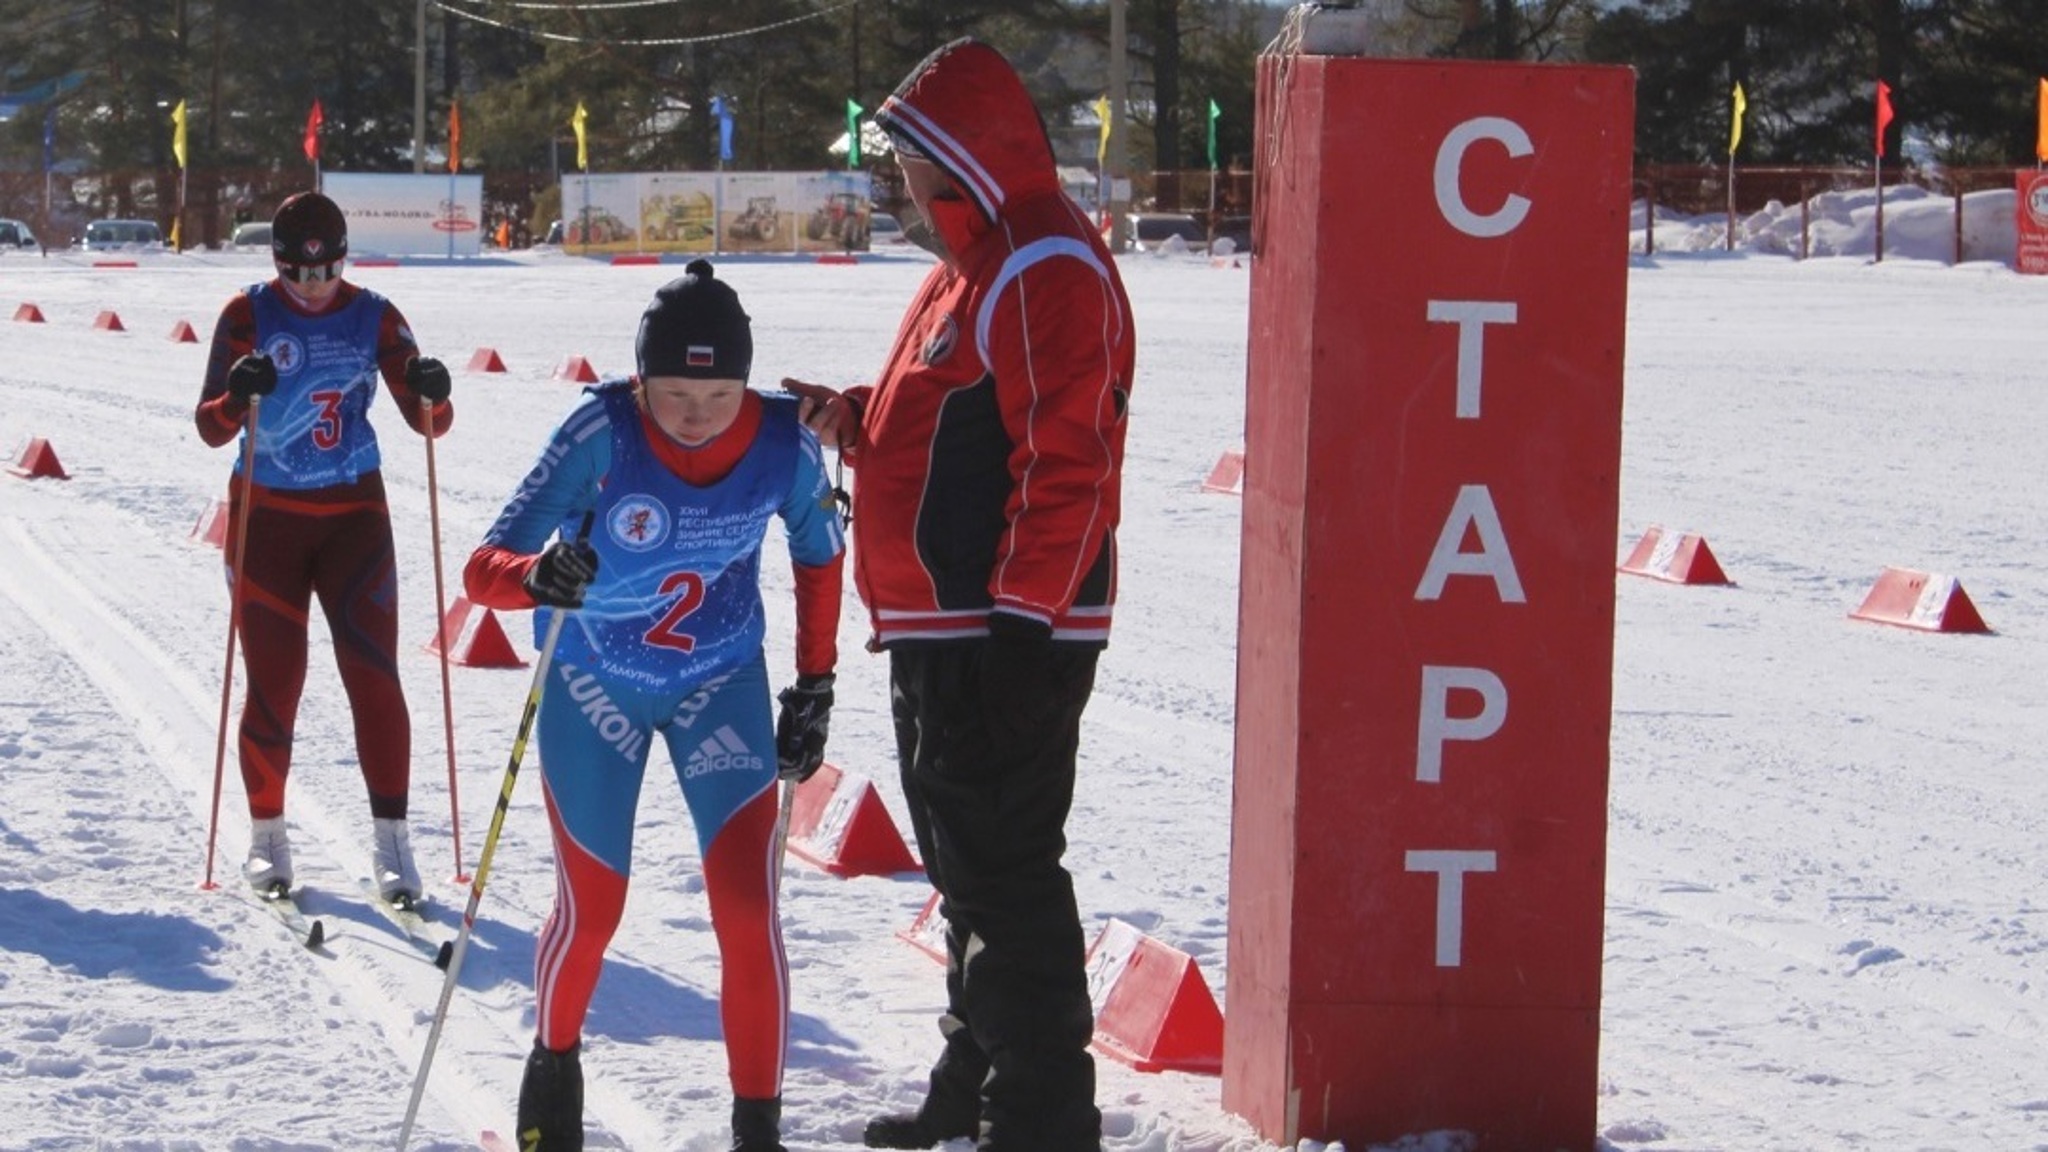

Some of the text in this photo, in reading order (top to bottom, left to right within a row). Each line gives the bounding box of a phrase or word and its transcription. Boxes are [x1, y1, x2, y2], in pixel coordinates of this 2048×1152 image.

[310, 389, 344, 450] 3
[1405, 116, 1535, 968] СТАРТ
[642, 571, 706, 654] 2
[680, 655, 723, 678] ВАВОЖ
[559, 663, 645, 764] LUKOIL
[684, 752, 763, 779] adidas
